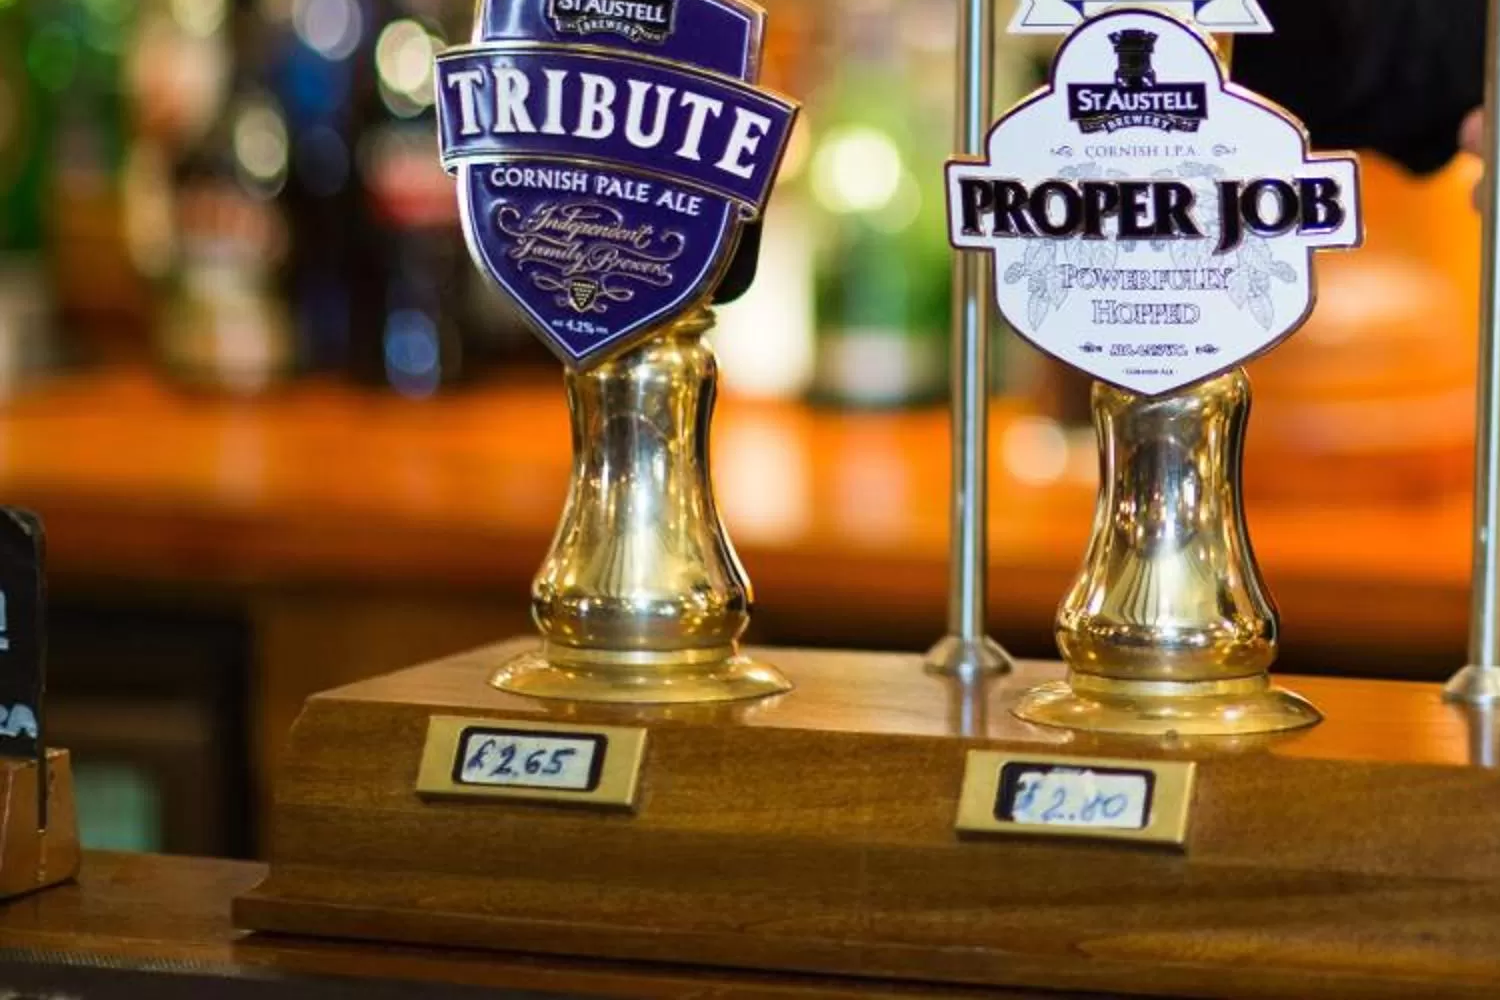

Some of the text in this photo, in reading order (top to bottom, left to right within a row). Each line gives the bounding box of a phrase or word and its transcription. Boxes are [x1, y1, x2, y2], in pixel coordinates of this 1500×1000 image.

[1105, 89, 1198, 111] AUSTELL
[447, 66, 771, 179] TRIBUTE
[1108, 115, 1170, 131] BREWERY
[1084, 144, 1159, 157] CORNISH
[490, 165, 701, 216] CORNISH PALE ALE
[958, 176, 1347, 257] PROPER JOB
[509, 236, 586, 276] Family
[1091, 299, 1201, 325] HOPPED
[466, 738, 578, 778] £2.65
